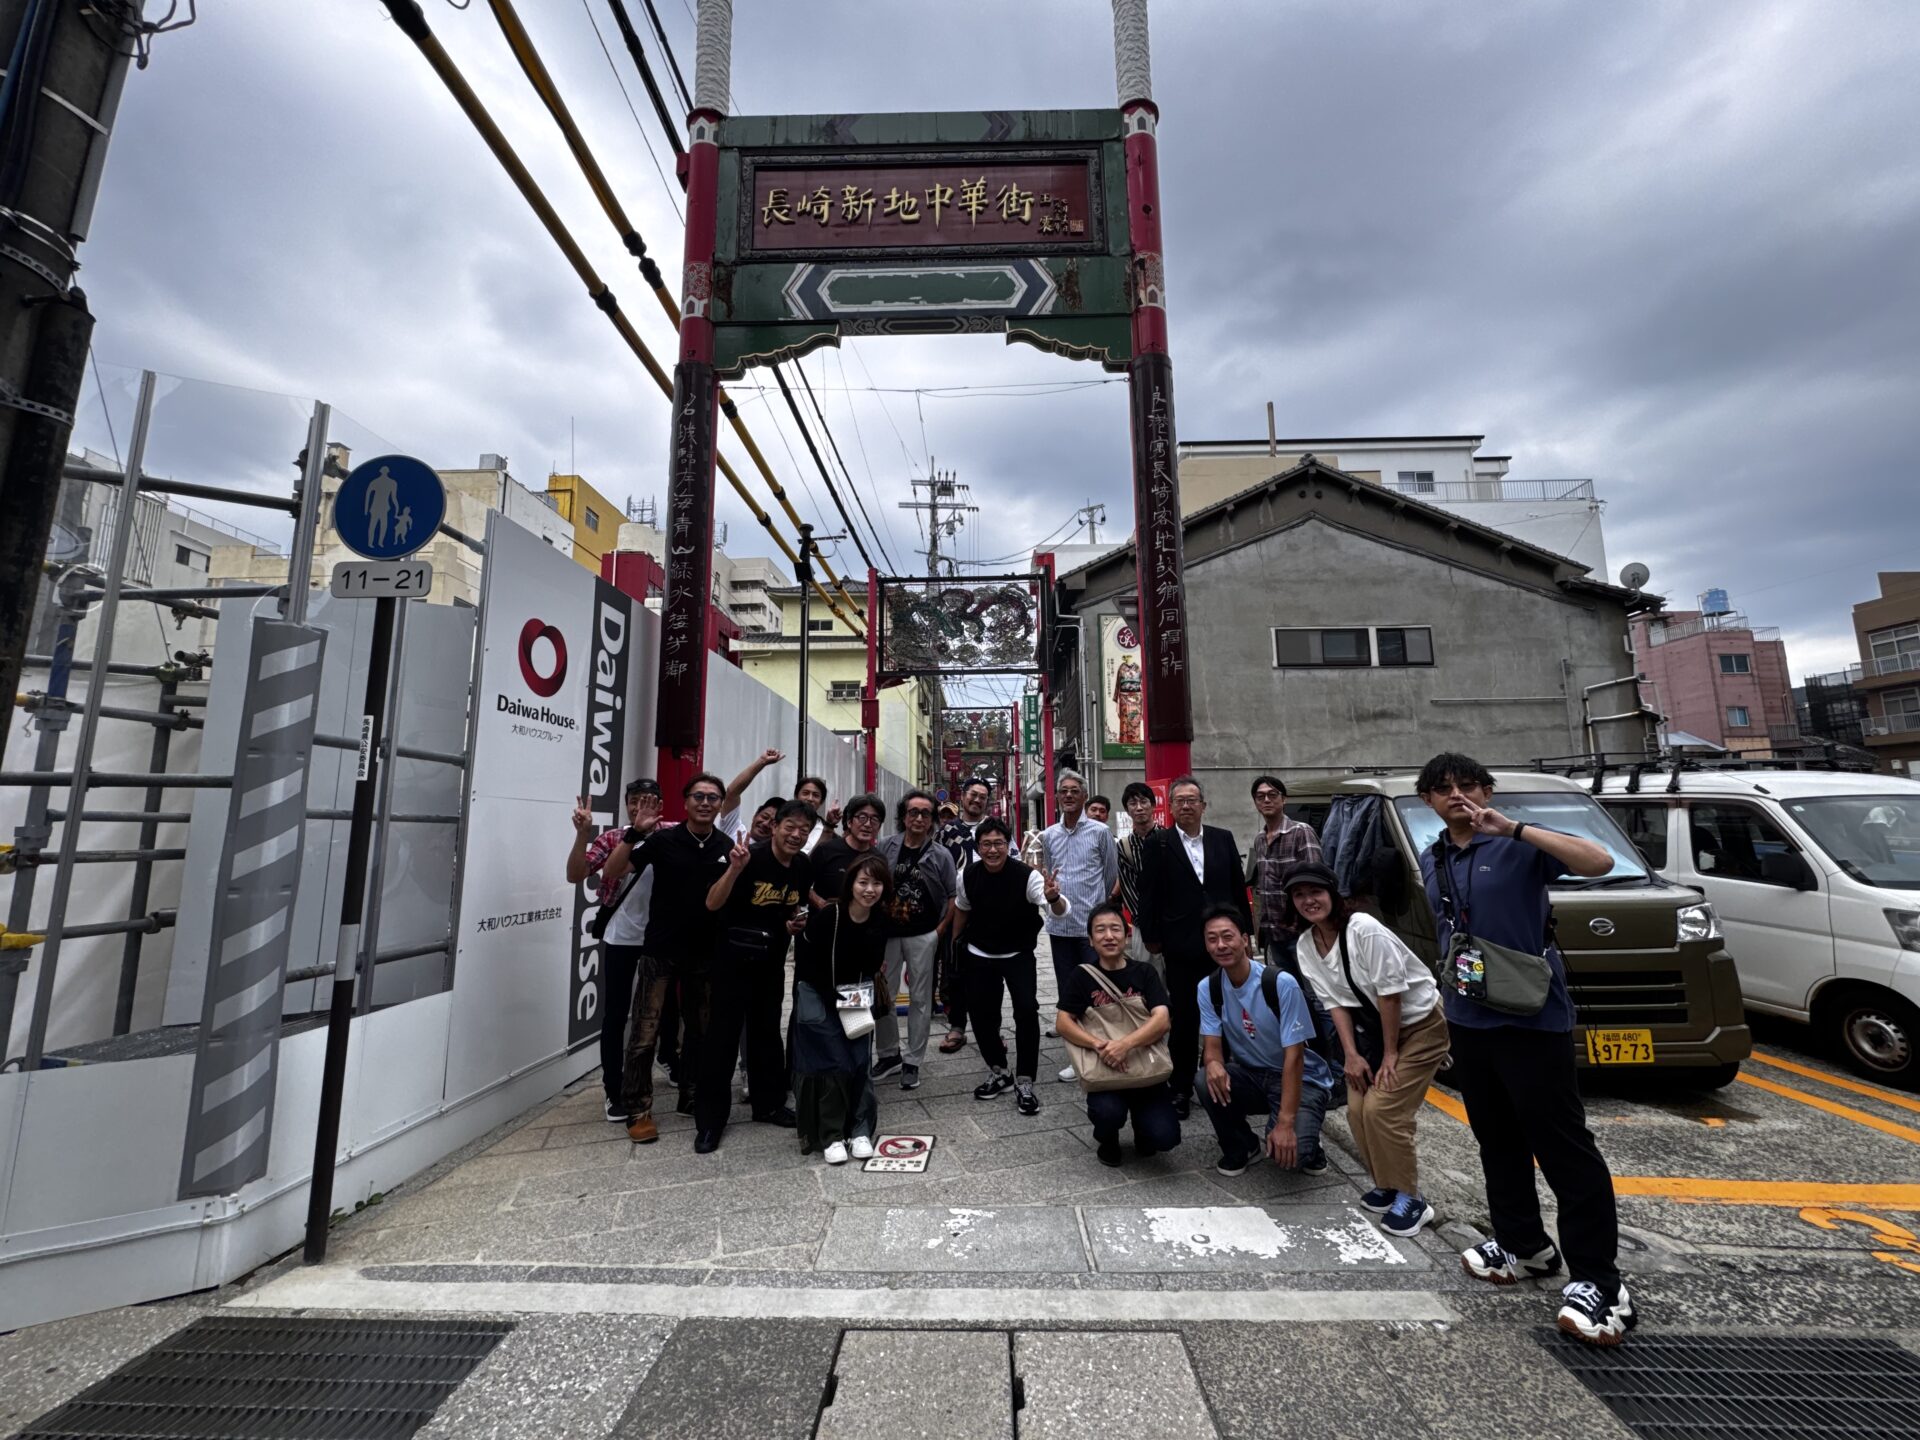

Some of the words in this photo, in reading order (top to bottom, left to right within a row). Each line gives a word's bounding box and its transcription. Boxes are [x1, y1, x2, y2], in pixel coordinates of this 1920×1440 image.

[761, 176, 1035, 231] 長崎新地中華街
[497, 694, 539, 721] Daiwa
[541, 706, 575, 730] House
[589, 601, 626, 797] Daiwa
[511, 724, 563, 743] 大和ハウスグループ
[477, 906, 562, 933] 大和ハウス工業株式会社
[1602, 1033, 1620, 1042] 福岡
[1622, 1033, 1638, 1042] 480
[1602, 1043, 1651, 1061] 97-73
